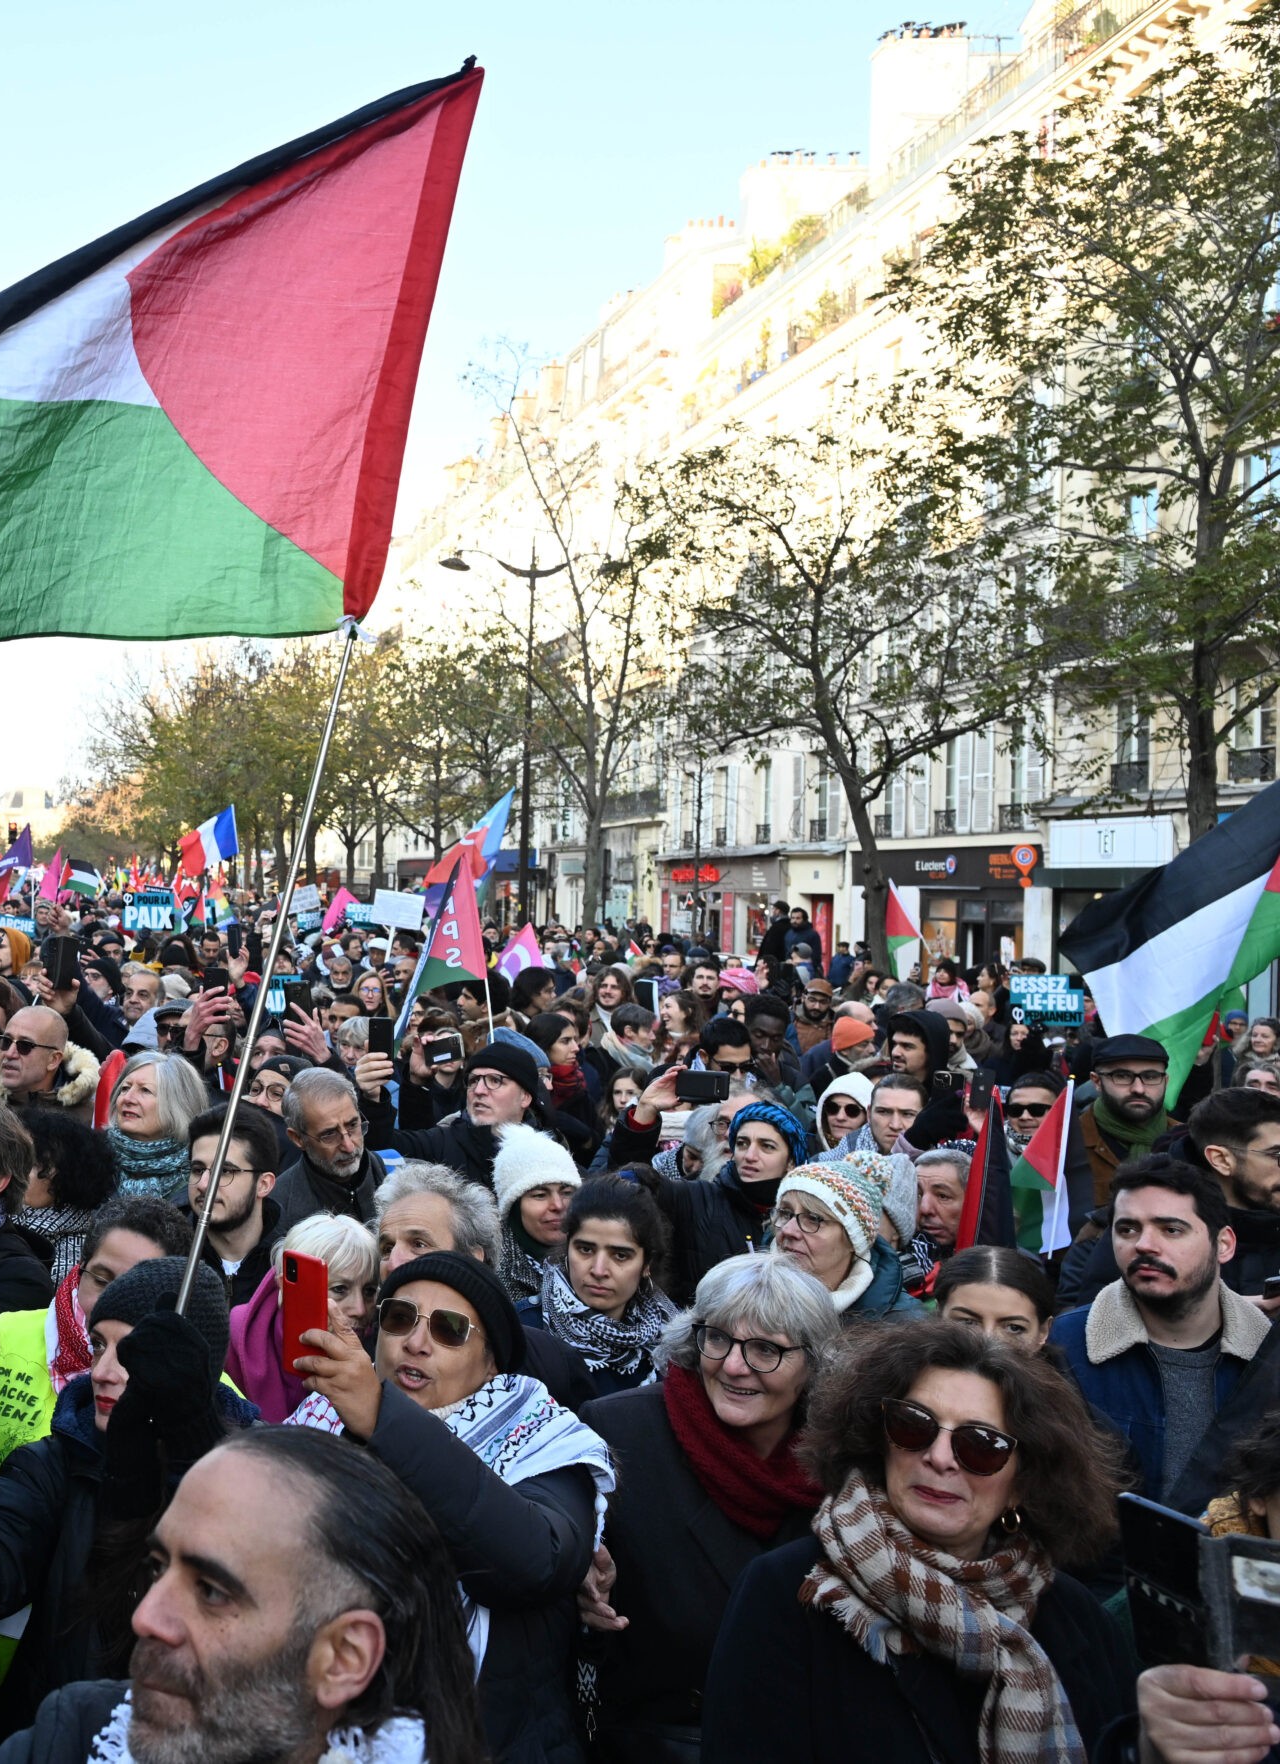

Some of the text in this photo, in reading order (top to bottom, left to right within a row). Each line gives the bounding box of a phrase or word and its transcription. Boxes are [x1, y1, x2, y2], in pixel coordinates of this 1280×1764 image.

[137, 895, 171, 905] POUR LA
[124, 906, 173, 929] PAIX
[1010, 976, 1067, 994] CESSEZ
[1022, 993, 1079, 1011] -LE-FEU
[1024, 1010, 1084, 1023] PERMANENT
[15, 1372, 33, 1386] NE
